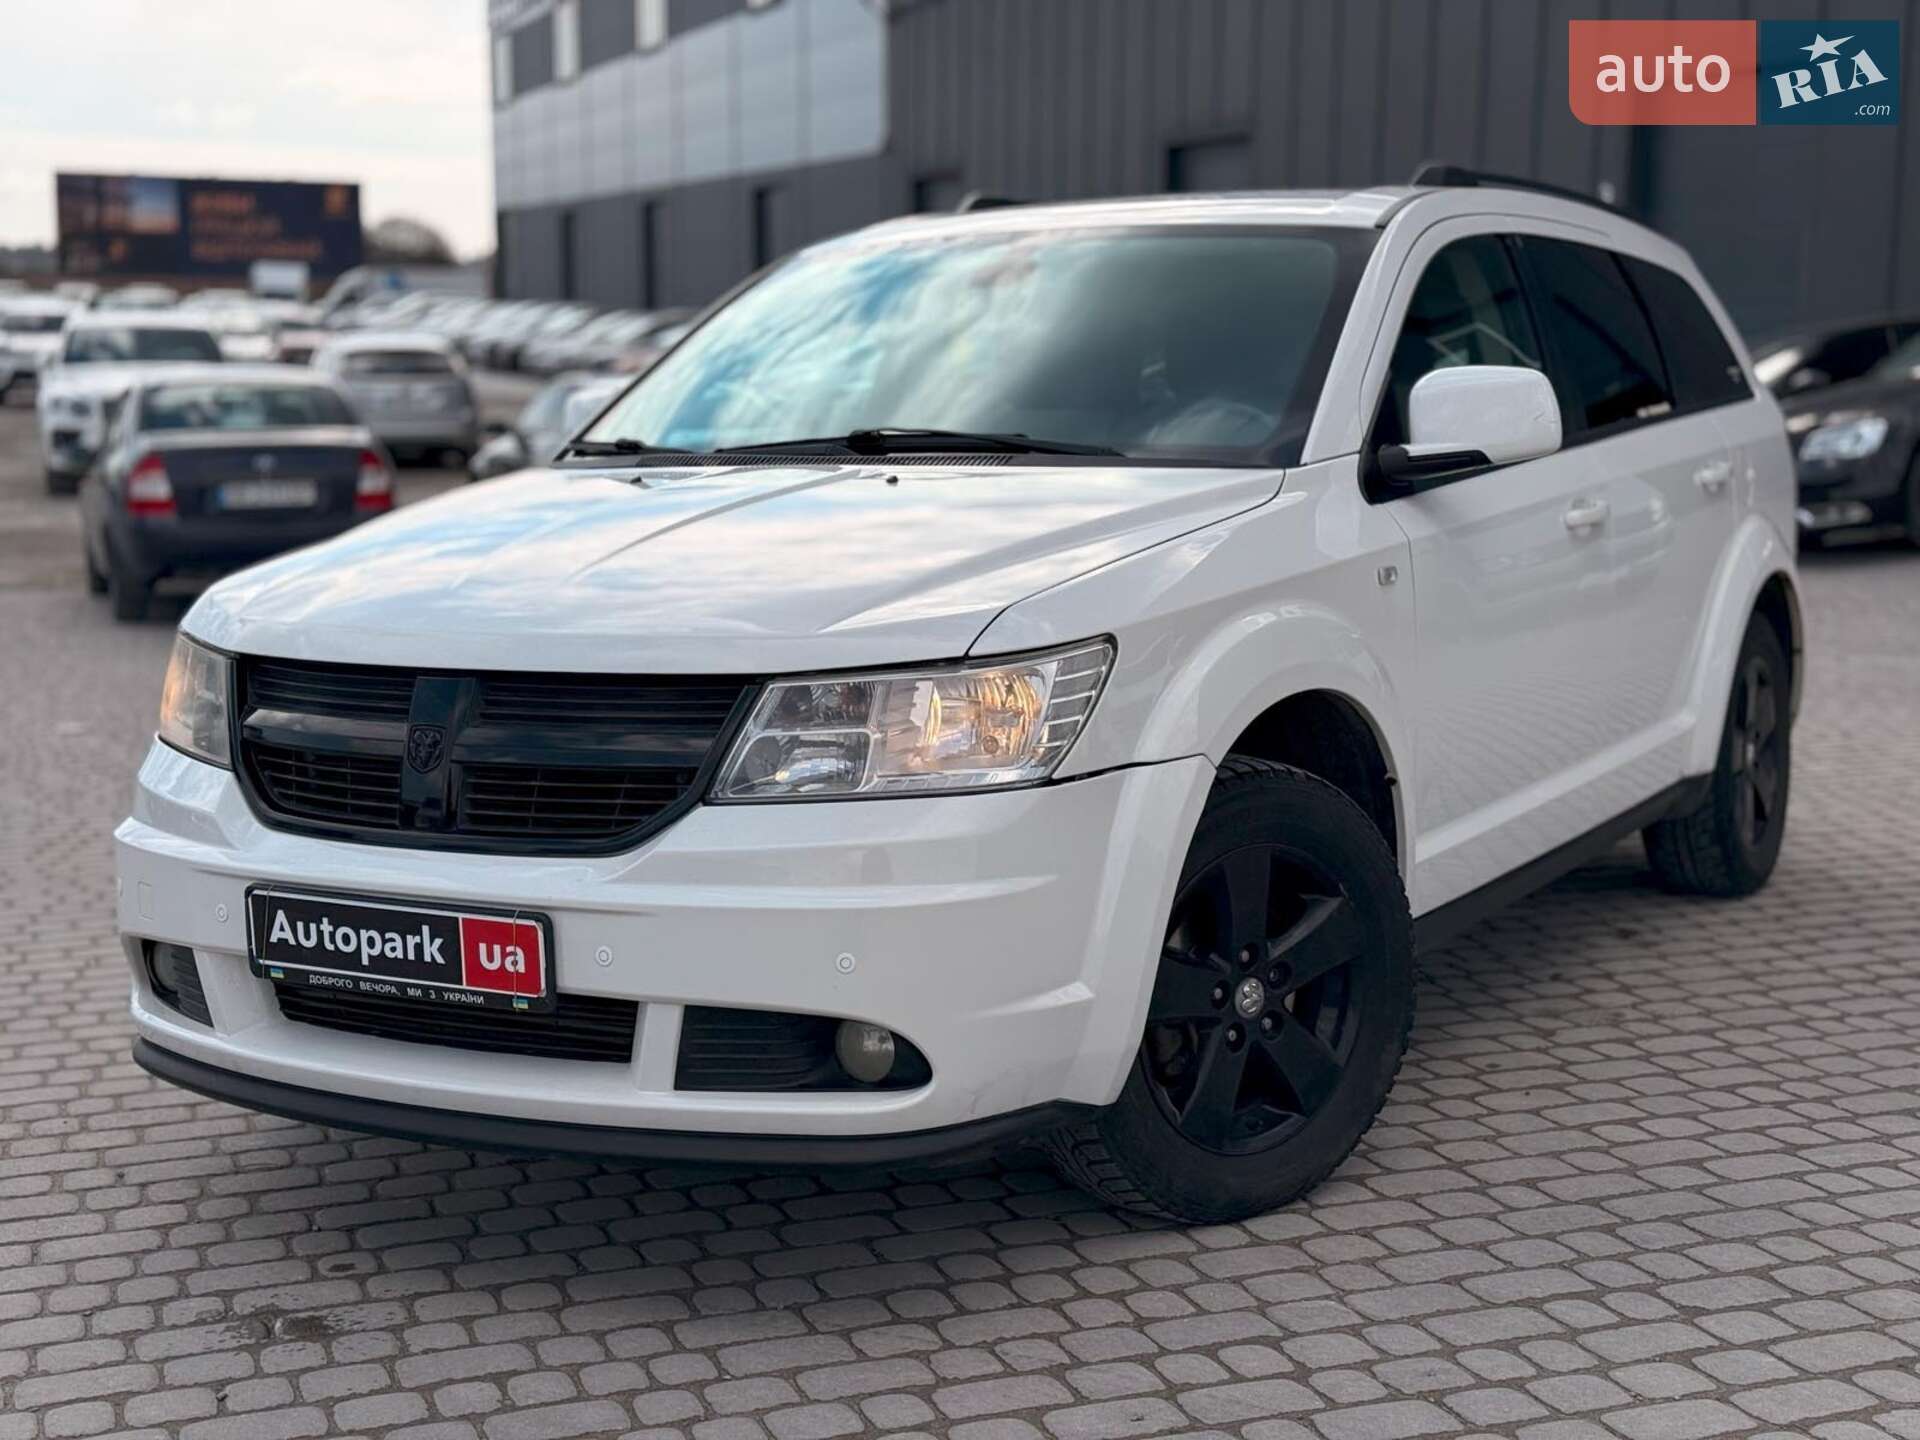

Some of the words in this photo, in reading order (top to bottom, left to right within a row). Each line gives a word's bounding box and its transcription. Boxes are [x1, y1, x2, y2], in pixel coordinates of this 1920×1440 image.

[269, 909, 446, 966] Autopark
[478, 942, 526, 974] ua
[309, 974, 353, 989] ДОБРОГО
[360, 981, 400, 996] ВЕЧОРА,
[407, 987, 422, 998] МИ
[443, 991, 485, 1005] УКРАЇНИ
